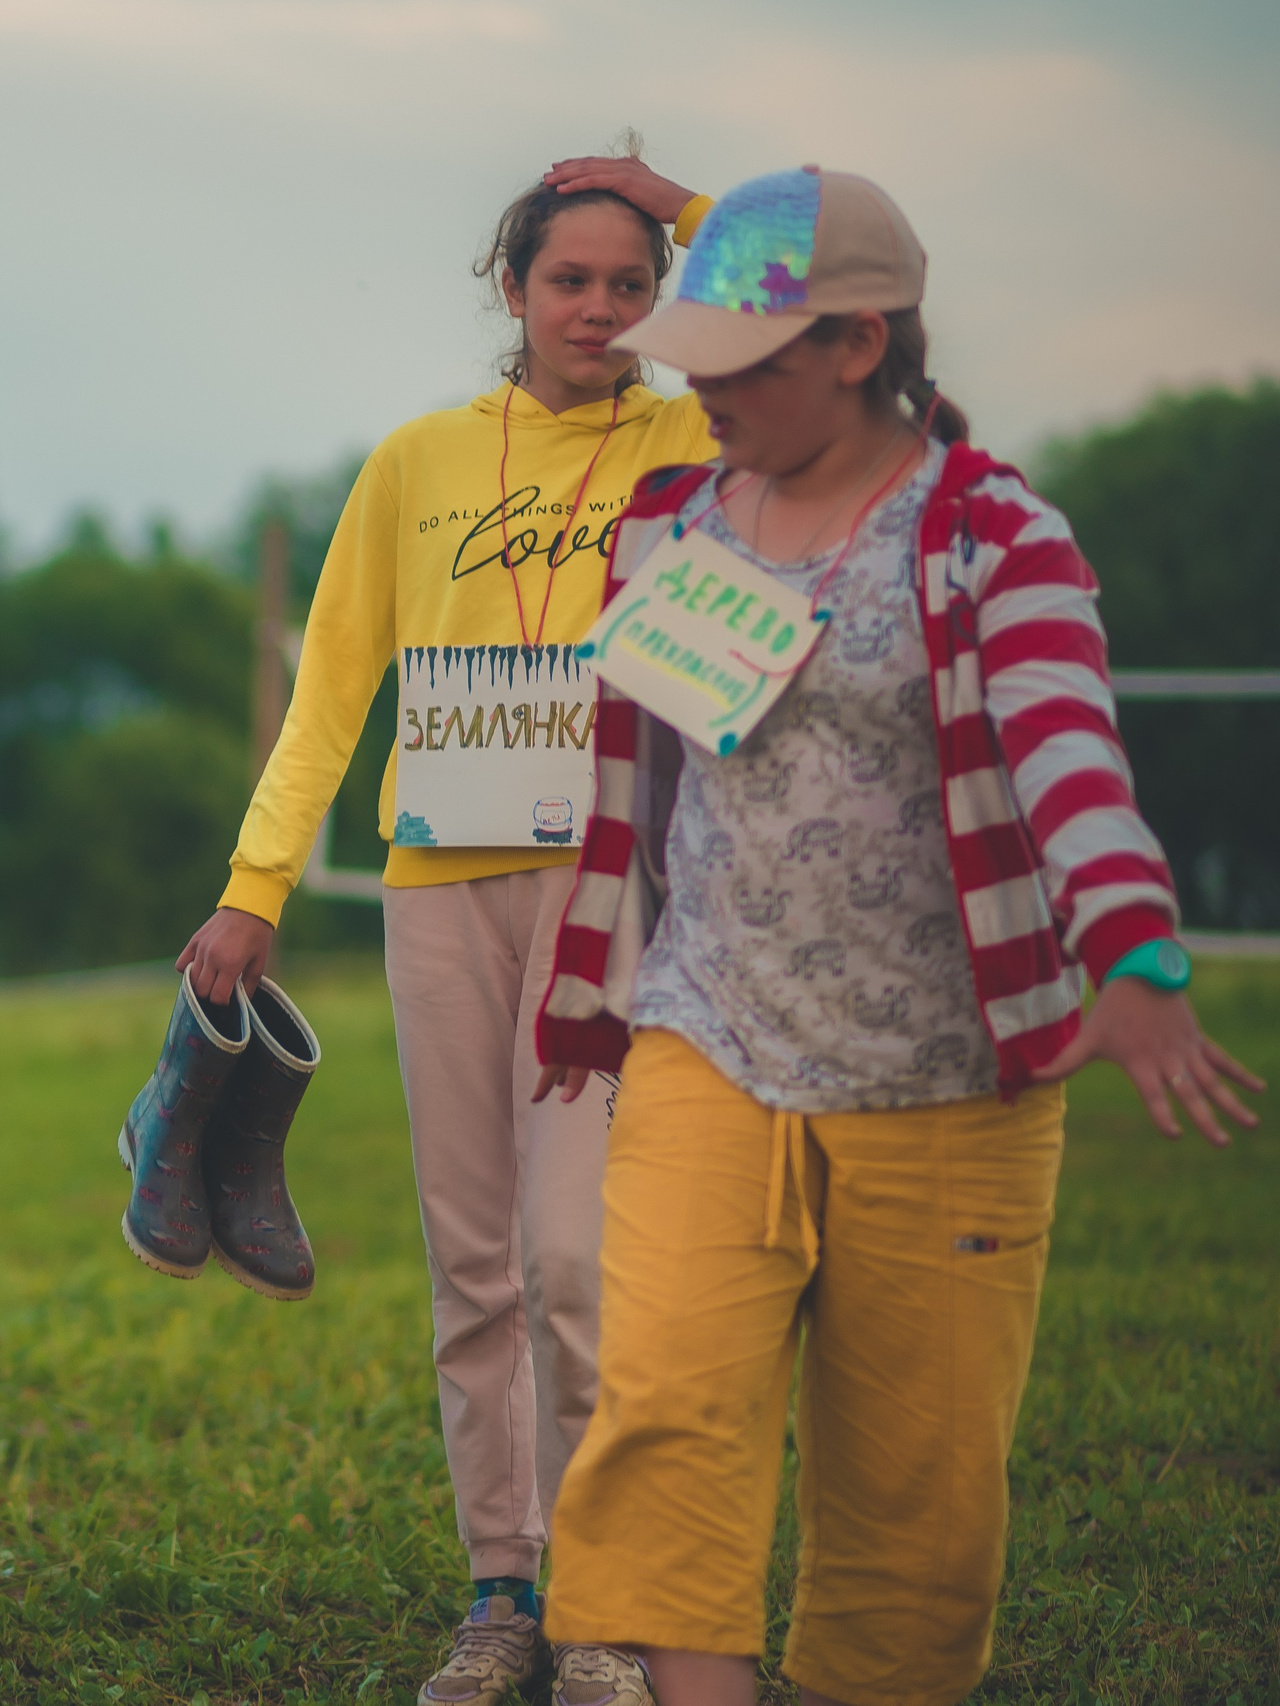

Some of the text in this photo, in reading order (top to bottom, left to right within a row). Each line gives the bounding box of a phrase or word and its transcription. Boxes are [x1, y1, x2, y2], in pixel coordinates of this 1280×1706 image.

[419, 515, 439, 533] DO
[448, 508, 485, 522] ALL
[653, 558, 795, 656] ДЕРЕВО
